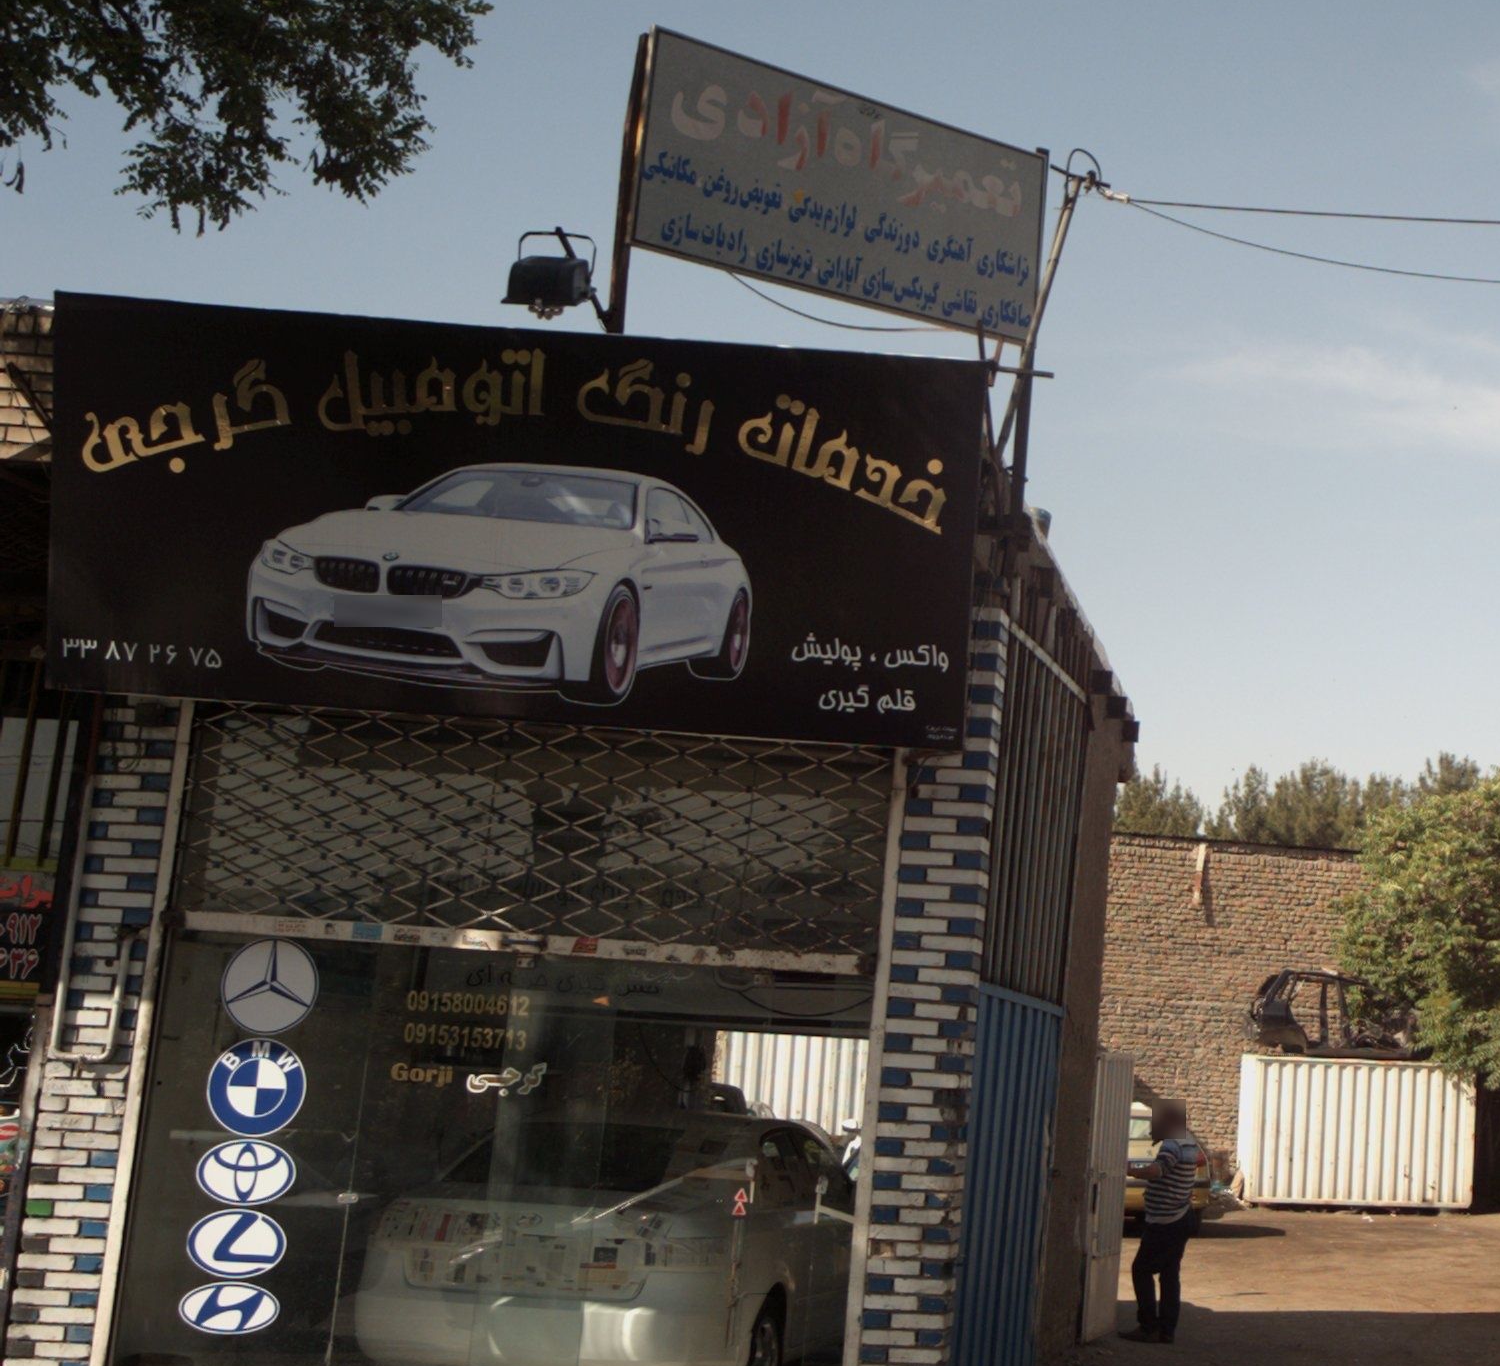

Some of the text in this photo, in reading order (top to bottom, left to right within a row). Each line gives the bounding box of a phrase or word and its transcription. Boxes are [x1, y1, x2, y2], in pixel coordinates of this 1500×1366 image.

[671, 84, 1022, 216] تعمیرگاه آزادی
[81, 347, 946, 534] خدمات رنگ اتومبیل گرجی
[105, 640, 138, 662] ۸۷
[791, 632, 862, 671] پولیش
[884, 644, 949, 672] واکس
[819, 685, 917, 714] قلم گیری
[221, 1040, 299, 1073] BMW
[391, 1063, 453, 1088] Gorji
[466, 1062, 548, 1096] گرجی
